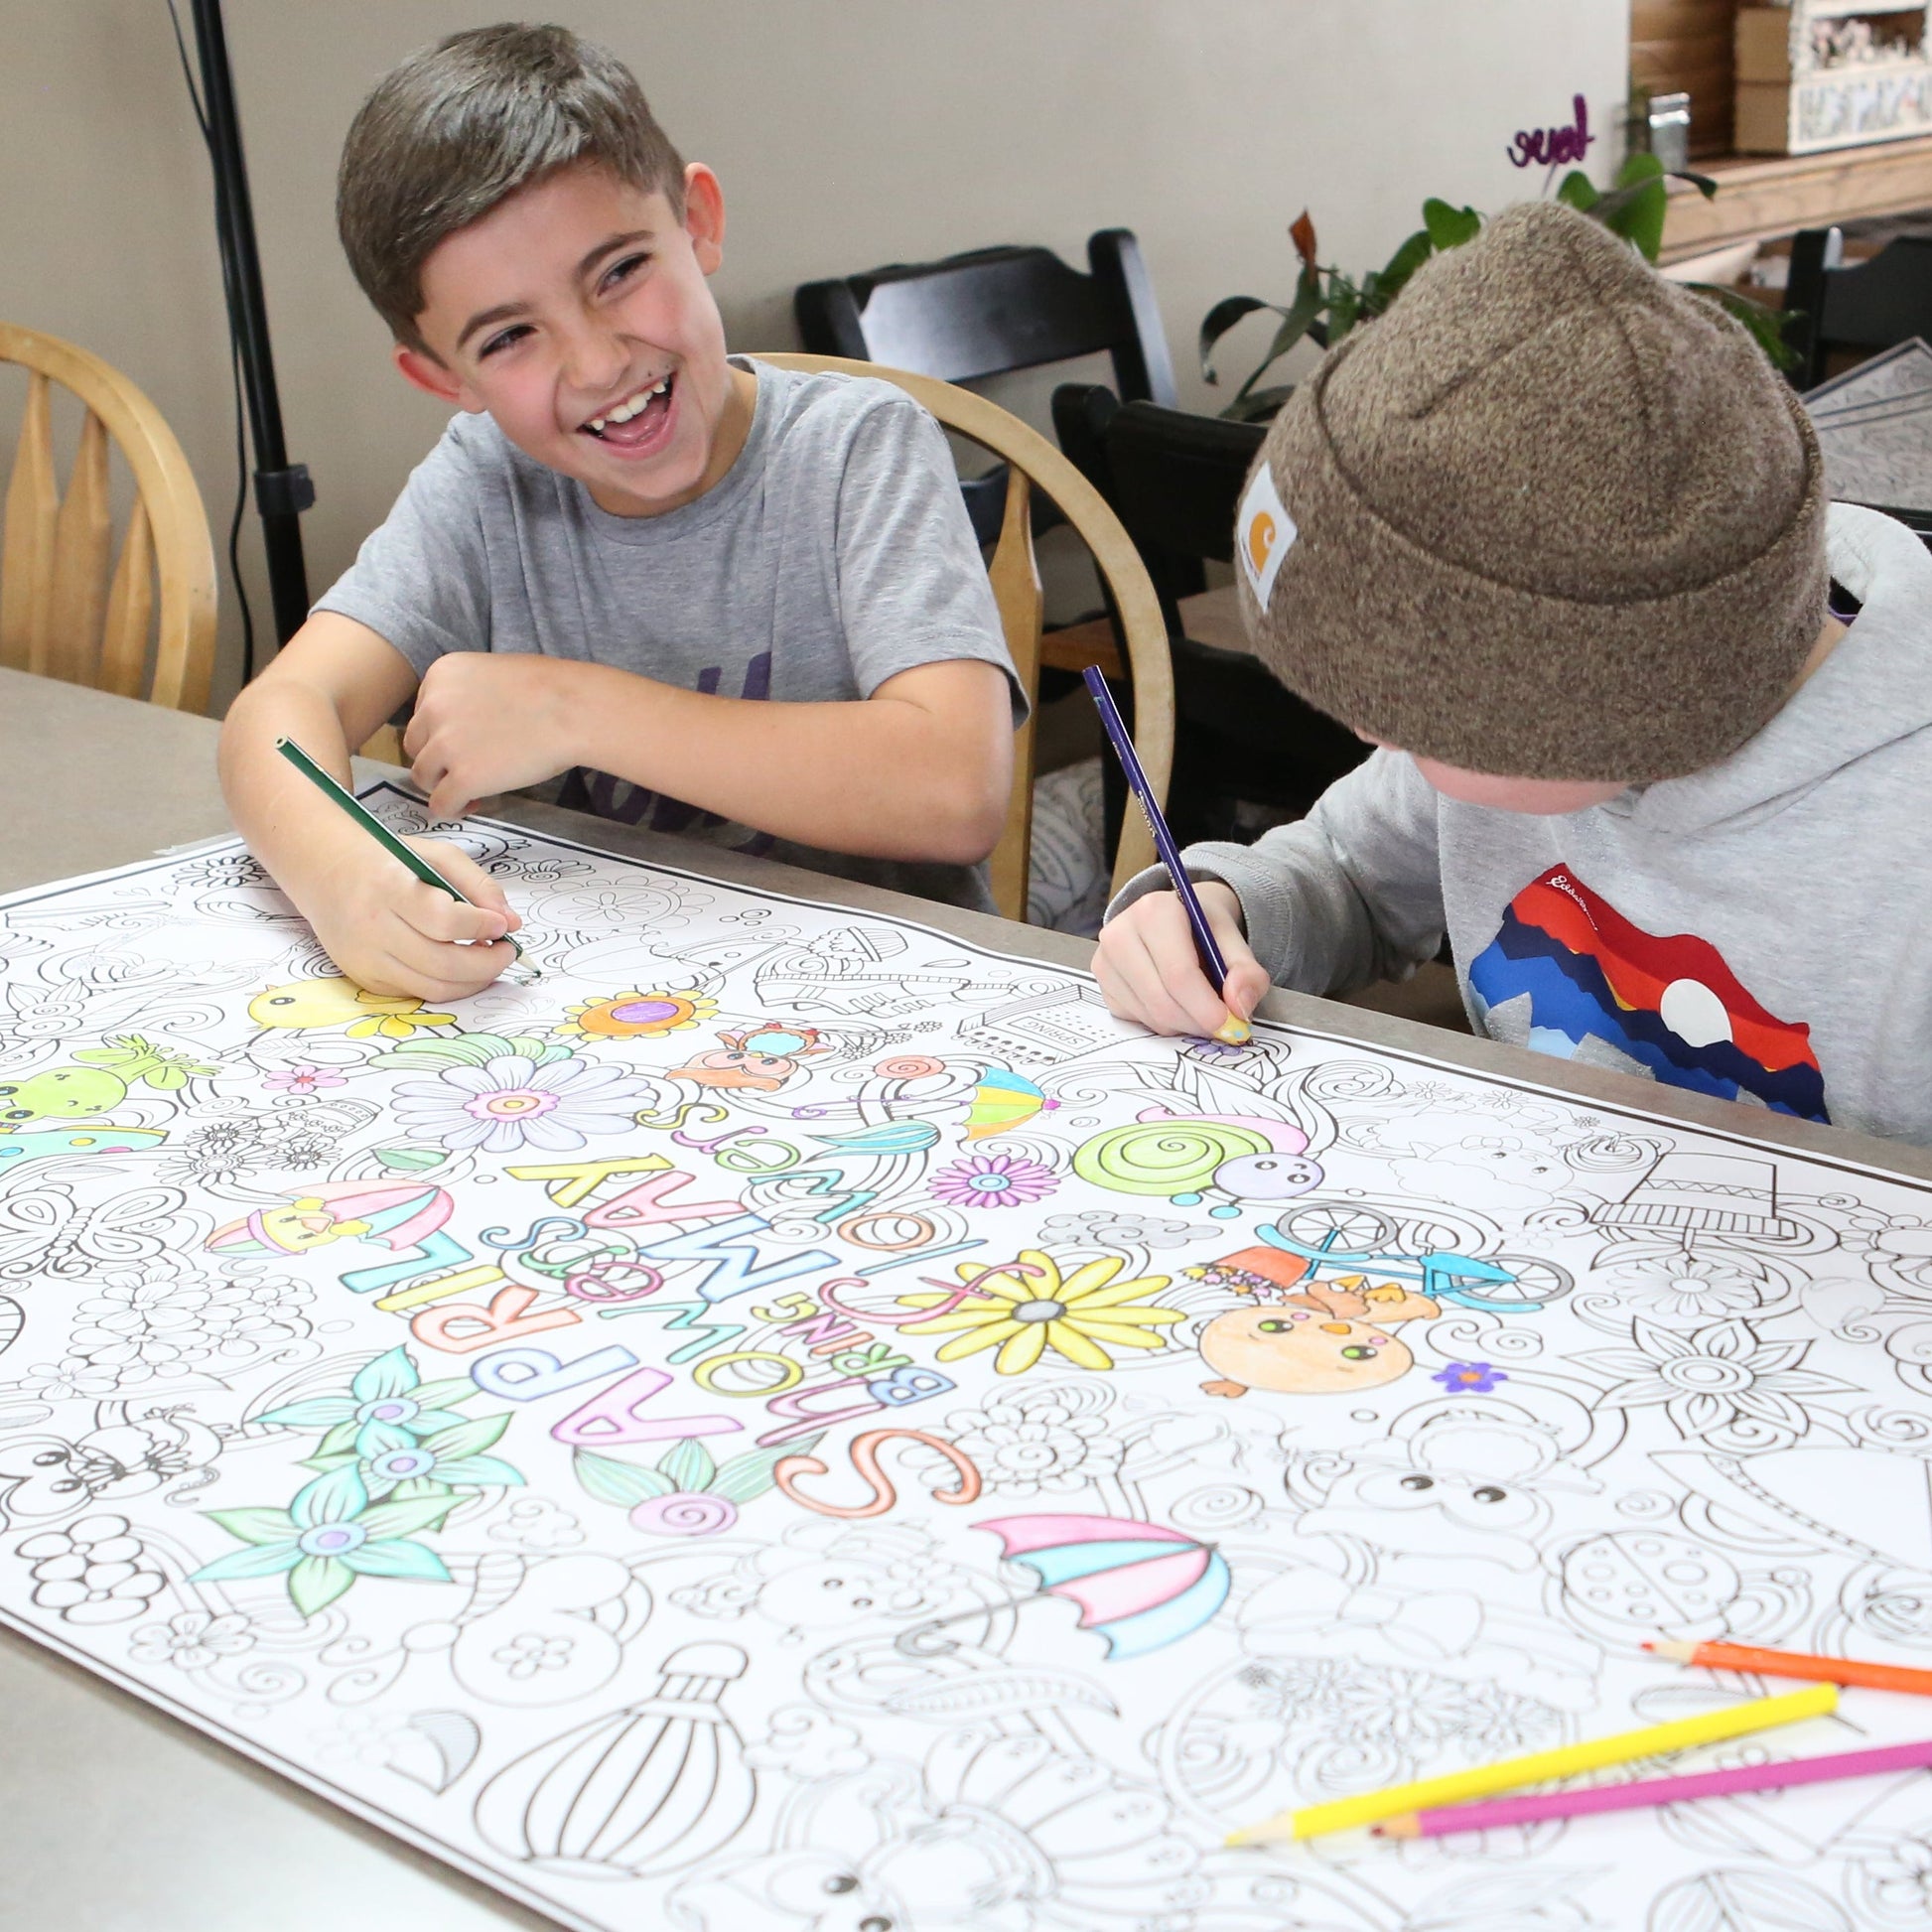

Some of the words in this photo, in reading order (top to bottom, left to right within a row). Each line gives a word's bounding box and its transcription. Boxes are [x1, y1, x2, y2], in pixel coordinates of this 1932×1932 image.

[1022, 1020, 1084, 1046] SPRING
[501, 1153, 843, 1304] MAY
[339, 1229, 745, 1446] APRIL
[751, 1293, 958, 1408] BRING
